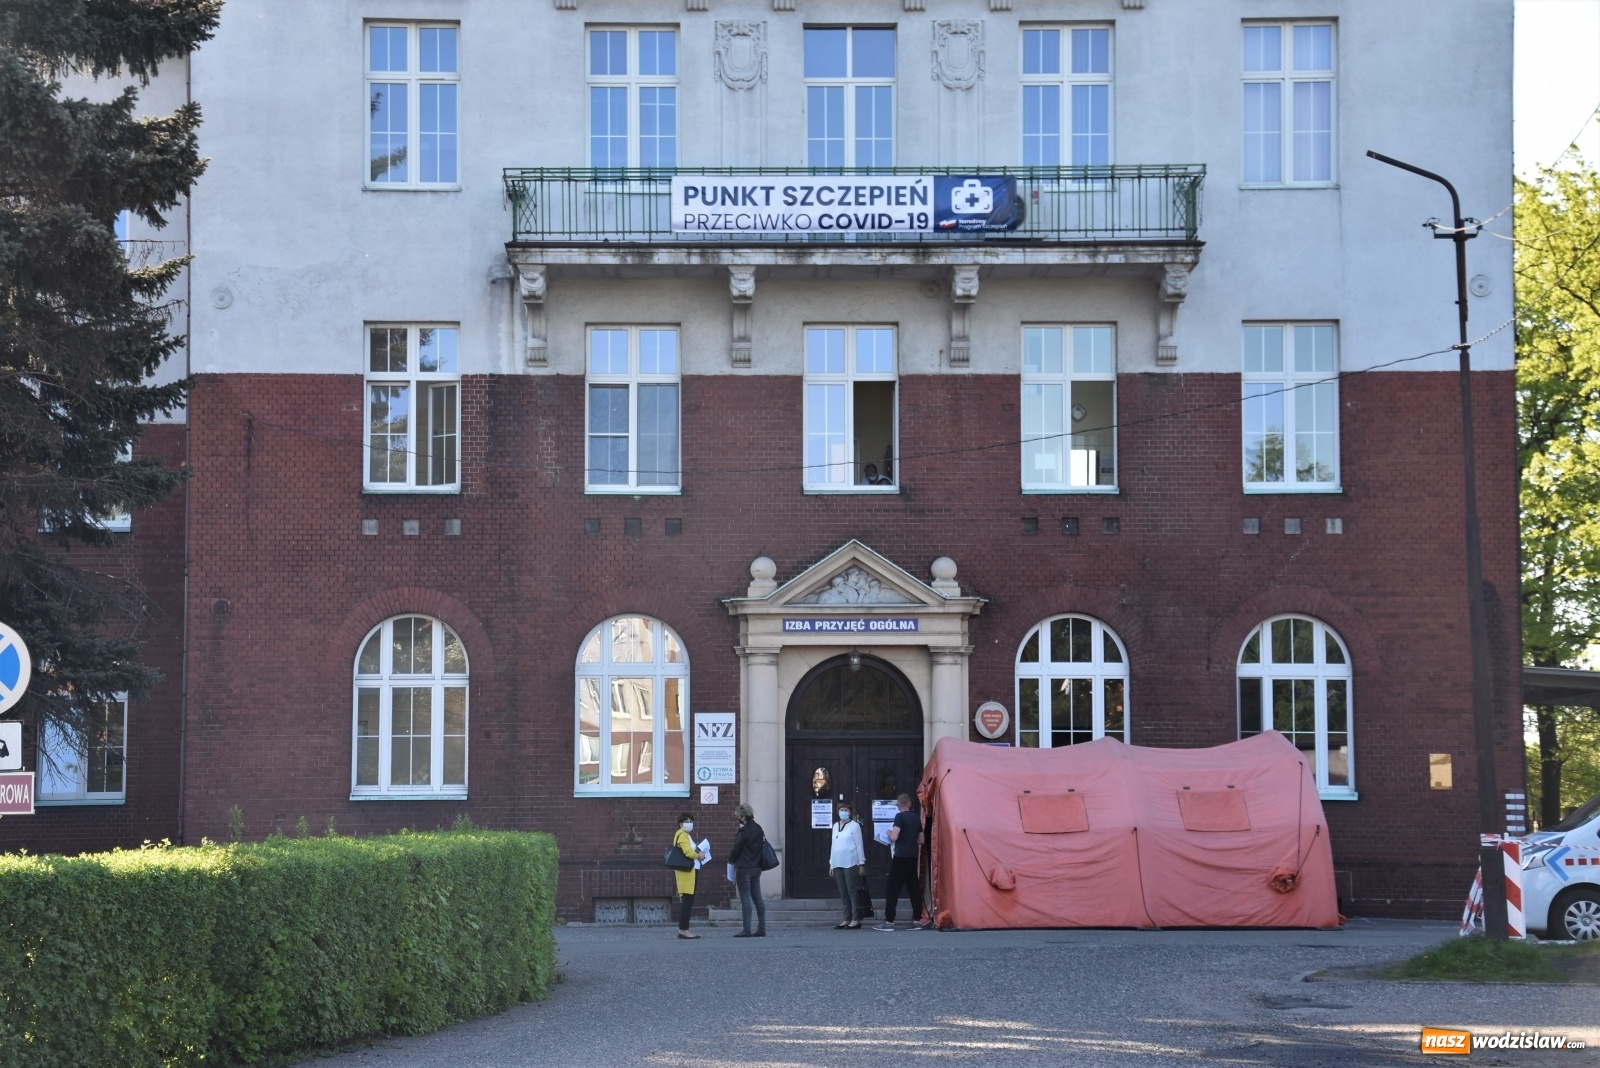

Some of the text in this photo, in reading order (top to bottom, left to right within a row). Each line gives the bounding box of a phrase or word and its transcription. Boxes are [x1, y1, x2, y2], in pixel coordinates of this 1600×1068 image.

[683, 178, 928, 207] PUNKT SZCZEPIEŃ
[684, 212, 930, 230] PRZECIWKO COVID-19
[785, 618, 916, 632] IZBA PRZYJĘĆ OGÓLNA
[697, 722, 734, 738] NFZ
